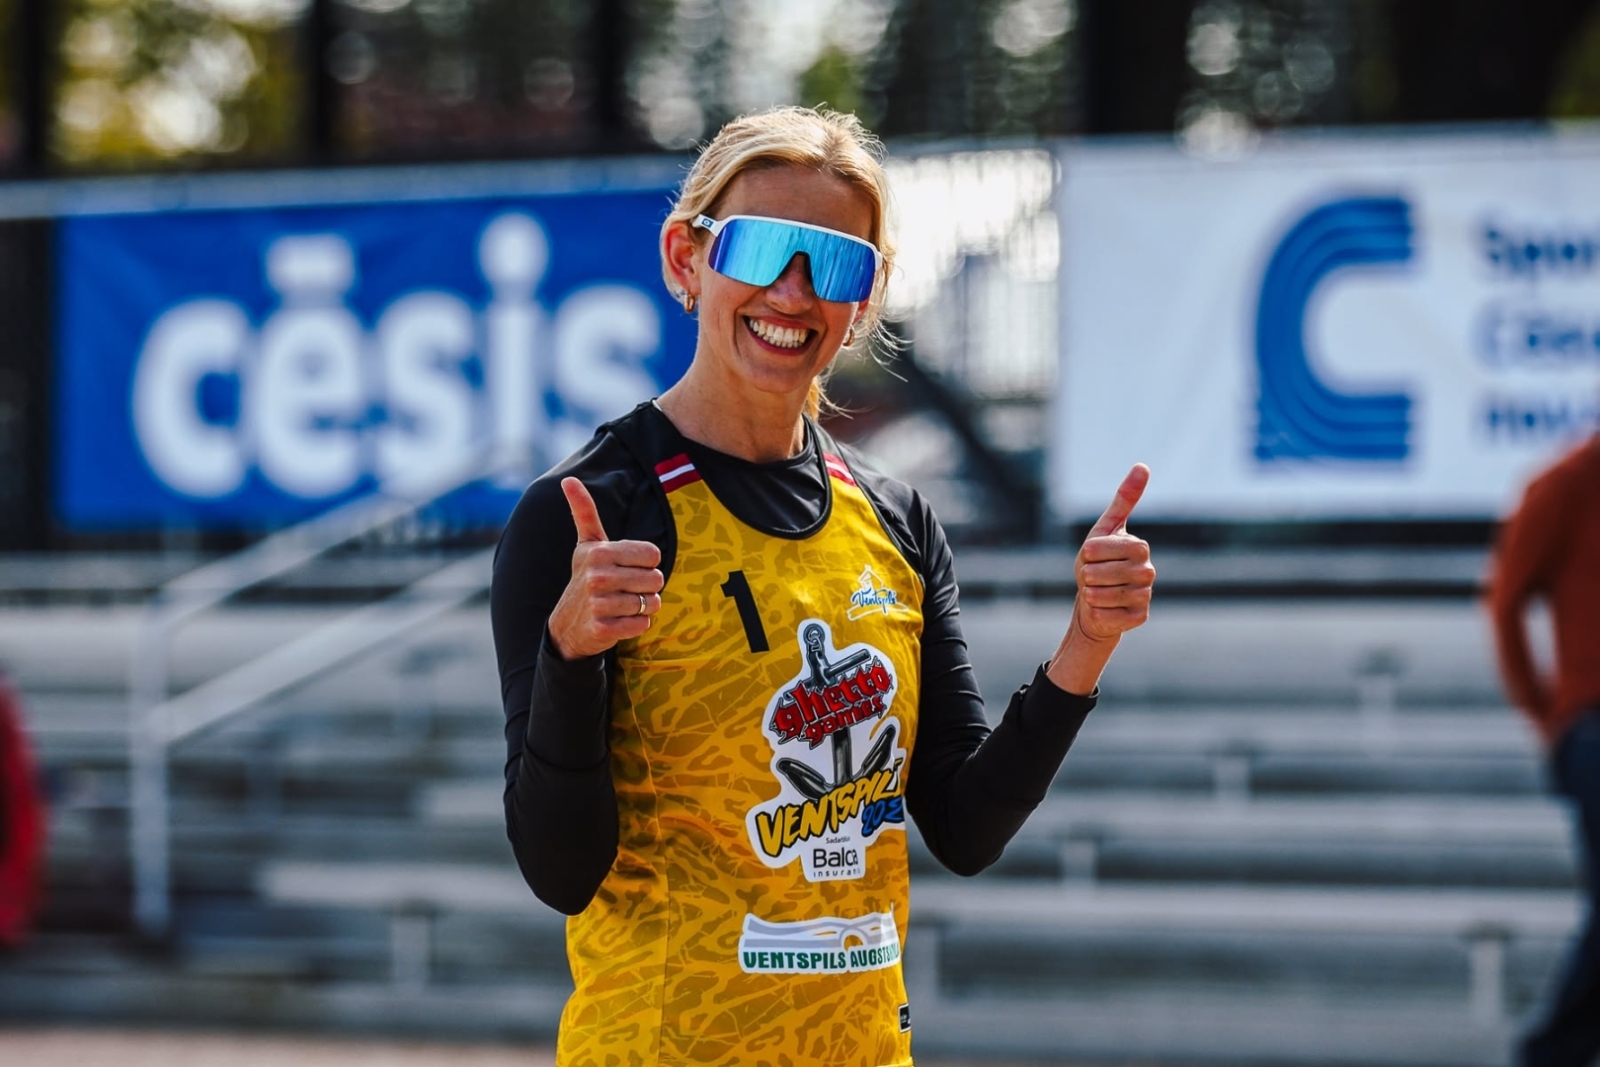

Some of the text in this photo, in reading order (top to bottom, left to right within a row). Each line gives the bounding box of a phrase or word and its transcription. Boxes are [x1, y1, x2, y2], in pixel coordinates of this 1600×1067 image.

[131, 212, 662, 499] cēsis
[720, 570, 770, 653] 1
[768, 656, 894, 745] ghetto
[797, 694, 887, 750] games
[861, 796, 906, 837] 202
[743, 942, 900, 970] VENTSPILS AUGSTS
